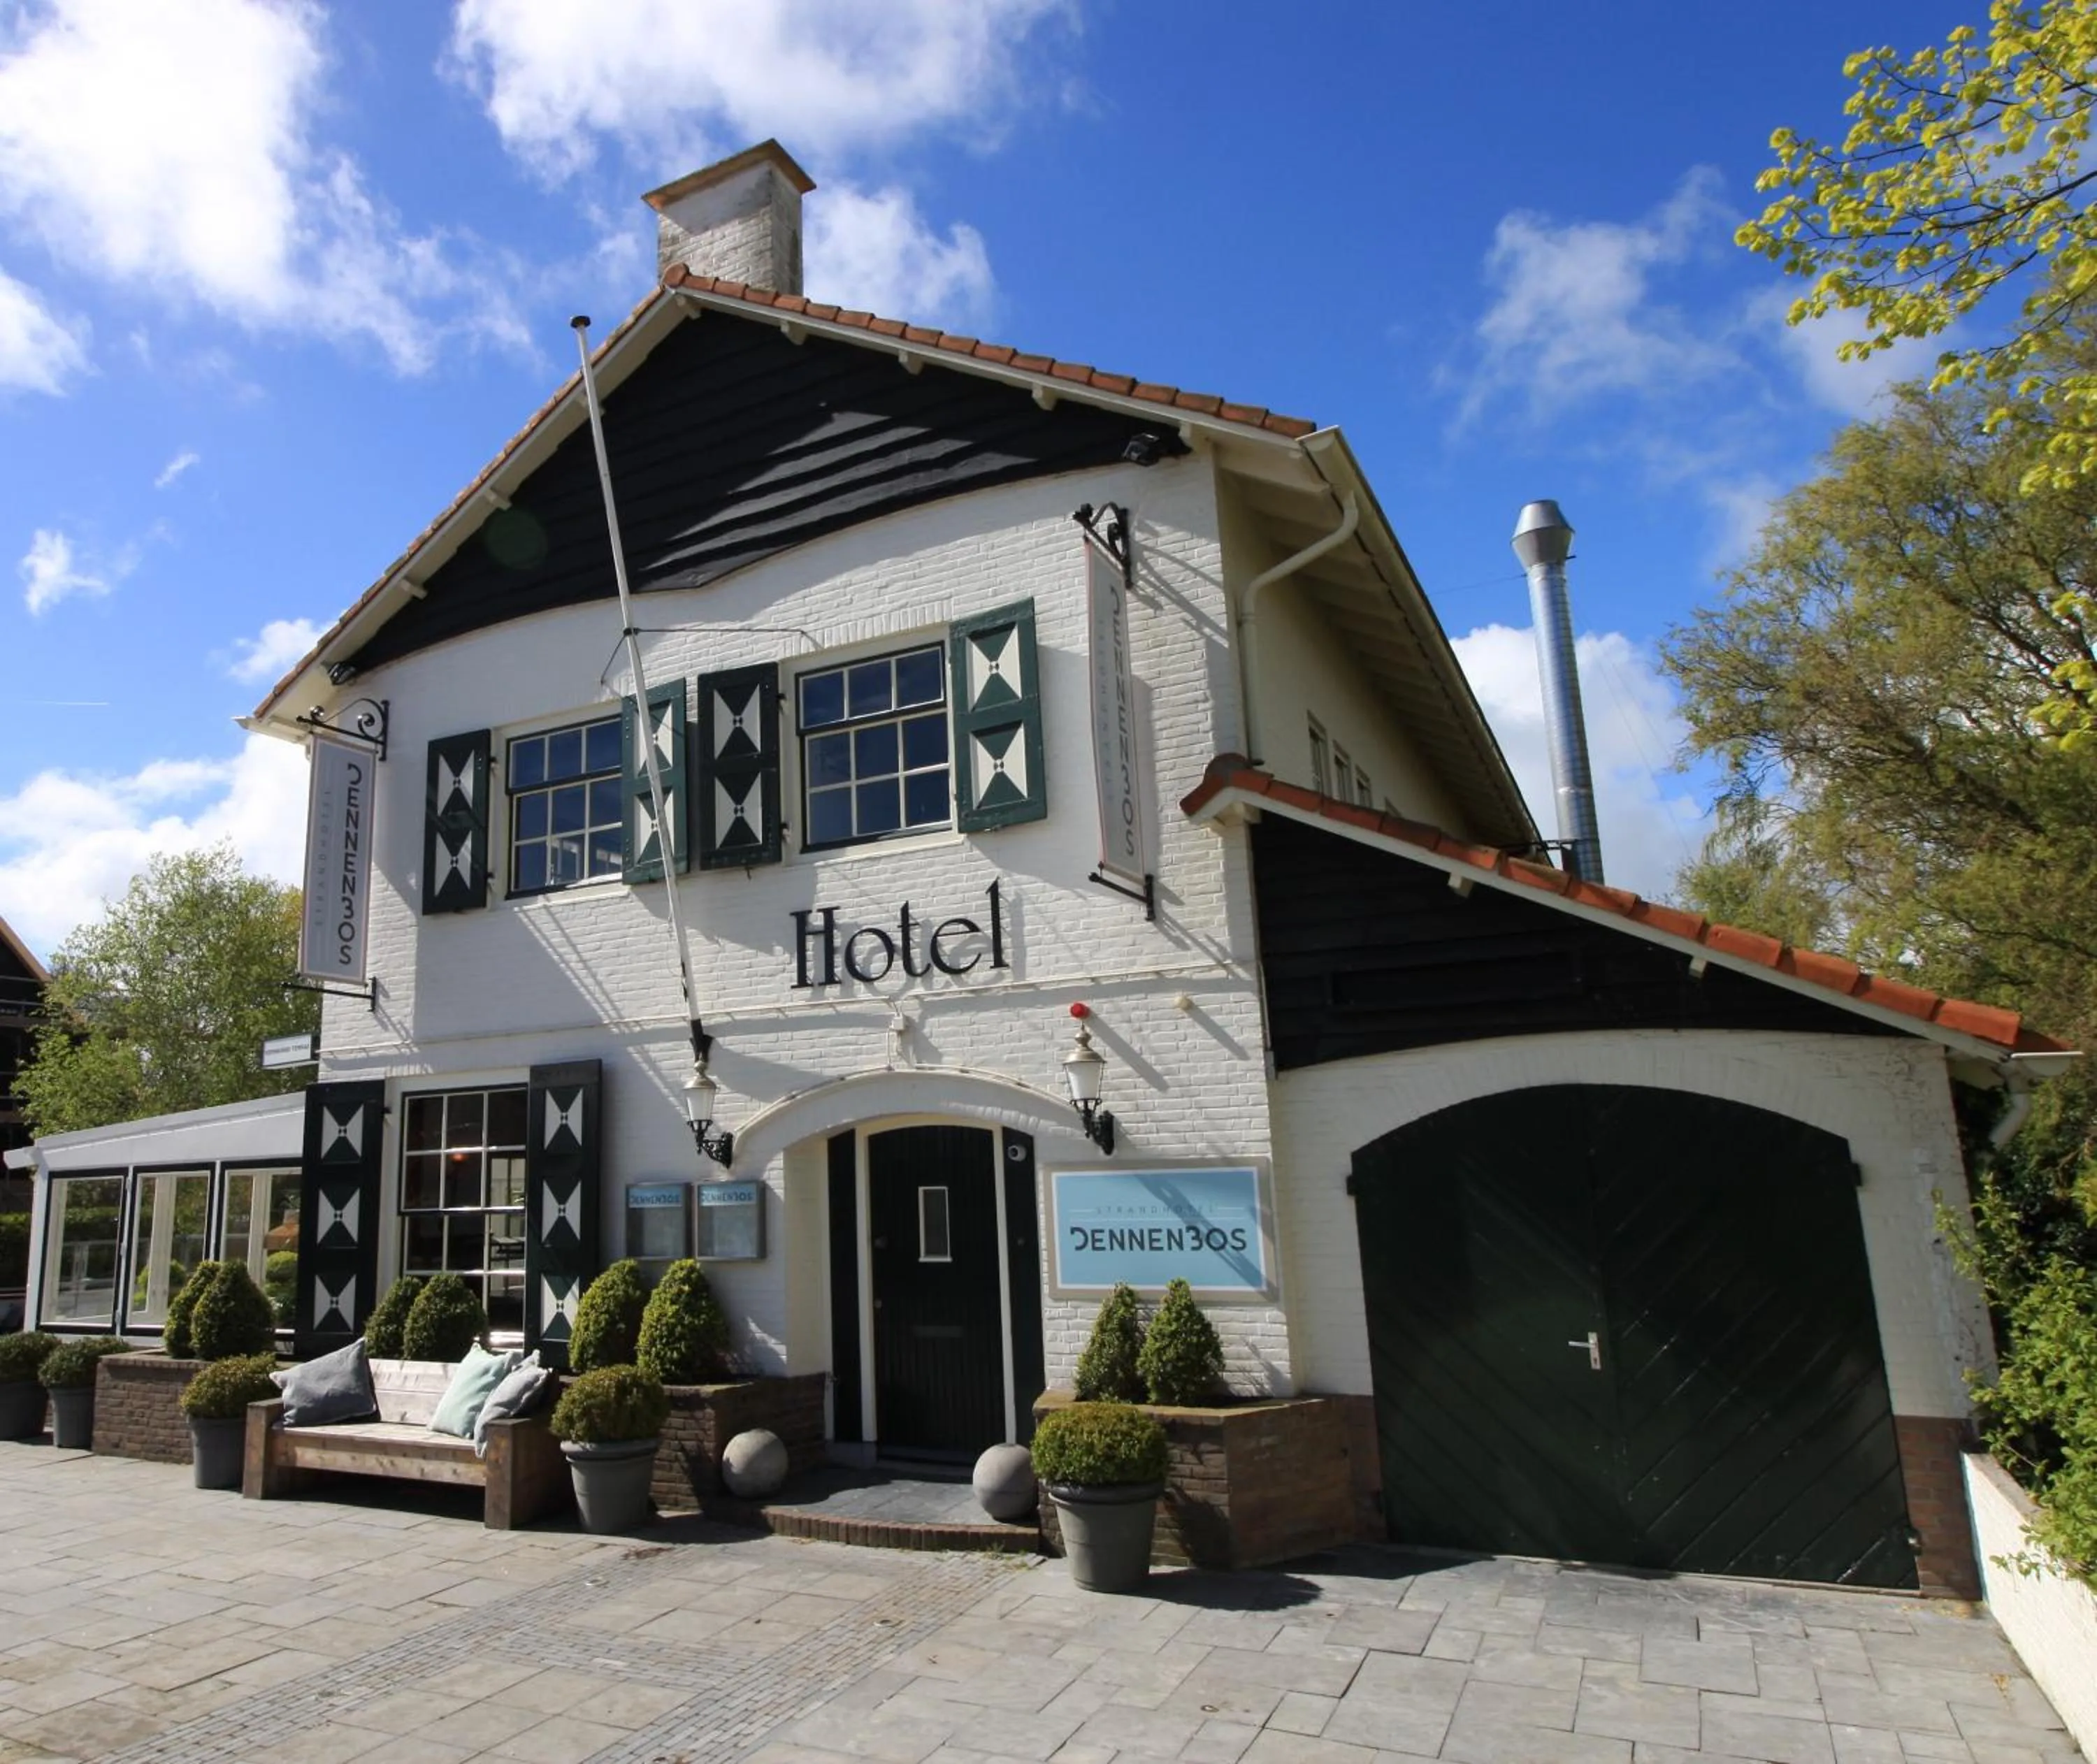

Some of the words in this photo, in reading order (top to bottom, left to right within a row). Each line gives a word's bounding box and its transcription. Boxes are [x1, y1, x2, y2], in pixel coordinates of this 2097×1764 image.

[338, 762, 362, 965] DENNENBOS
[790, 876, 1009, 988] Hotel
[1070, 1226, 1247, 1251] DENNENBOS
